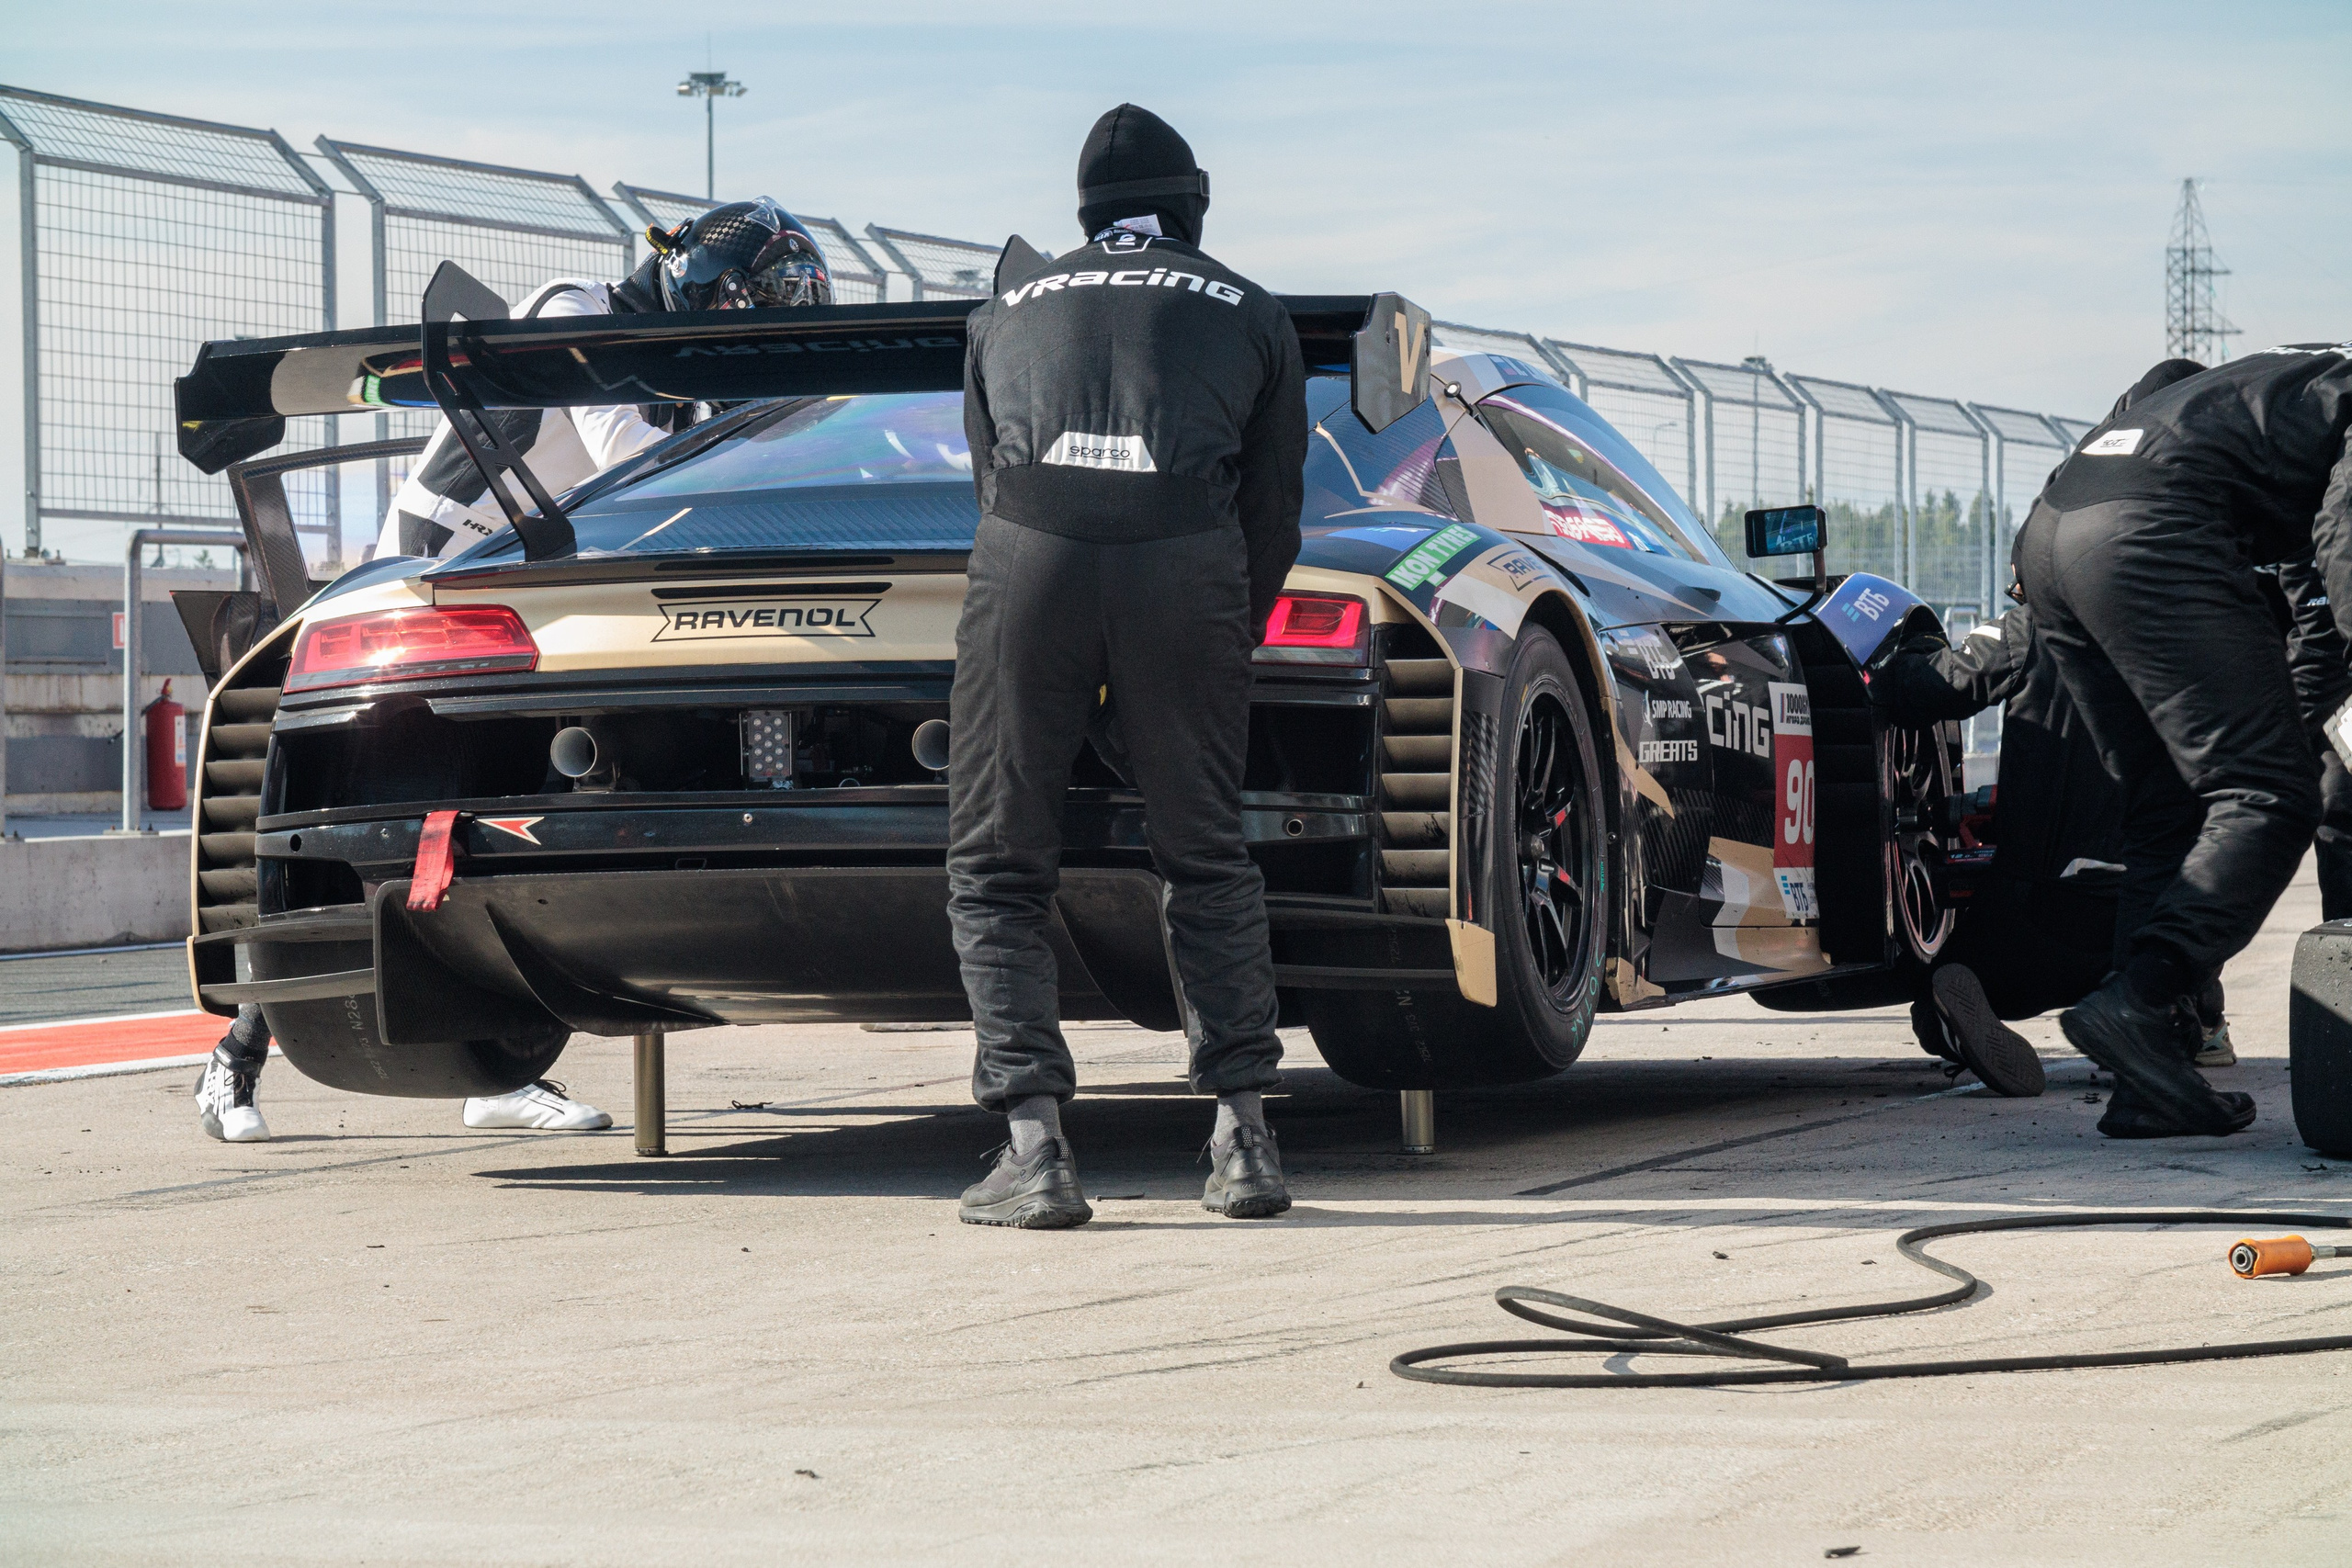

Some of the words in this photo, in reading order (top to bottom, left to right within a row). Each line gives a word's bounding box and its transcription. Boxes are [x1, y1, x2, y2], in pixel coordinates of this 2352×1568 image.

[1395, 311, 1424, 394] V
[1069, 446, 1130, 459] sparco
[1389, 547, 1440, 590] IKON
[1429, 525, 1479, 558] TYRES
[674, 607, 856, 631] RAVENOL
[1854, 588, 1890, 622] ВТБ
[1652, 699, 1668, 719] SMP
[1668, 700, 1691, 718] RACING
[1639, 740, 1698, 763] GREATS
[1784, 759, 1815, 845] 90
[1790, 882, 1809, 911] ВТБ
